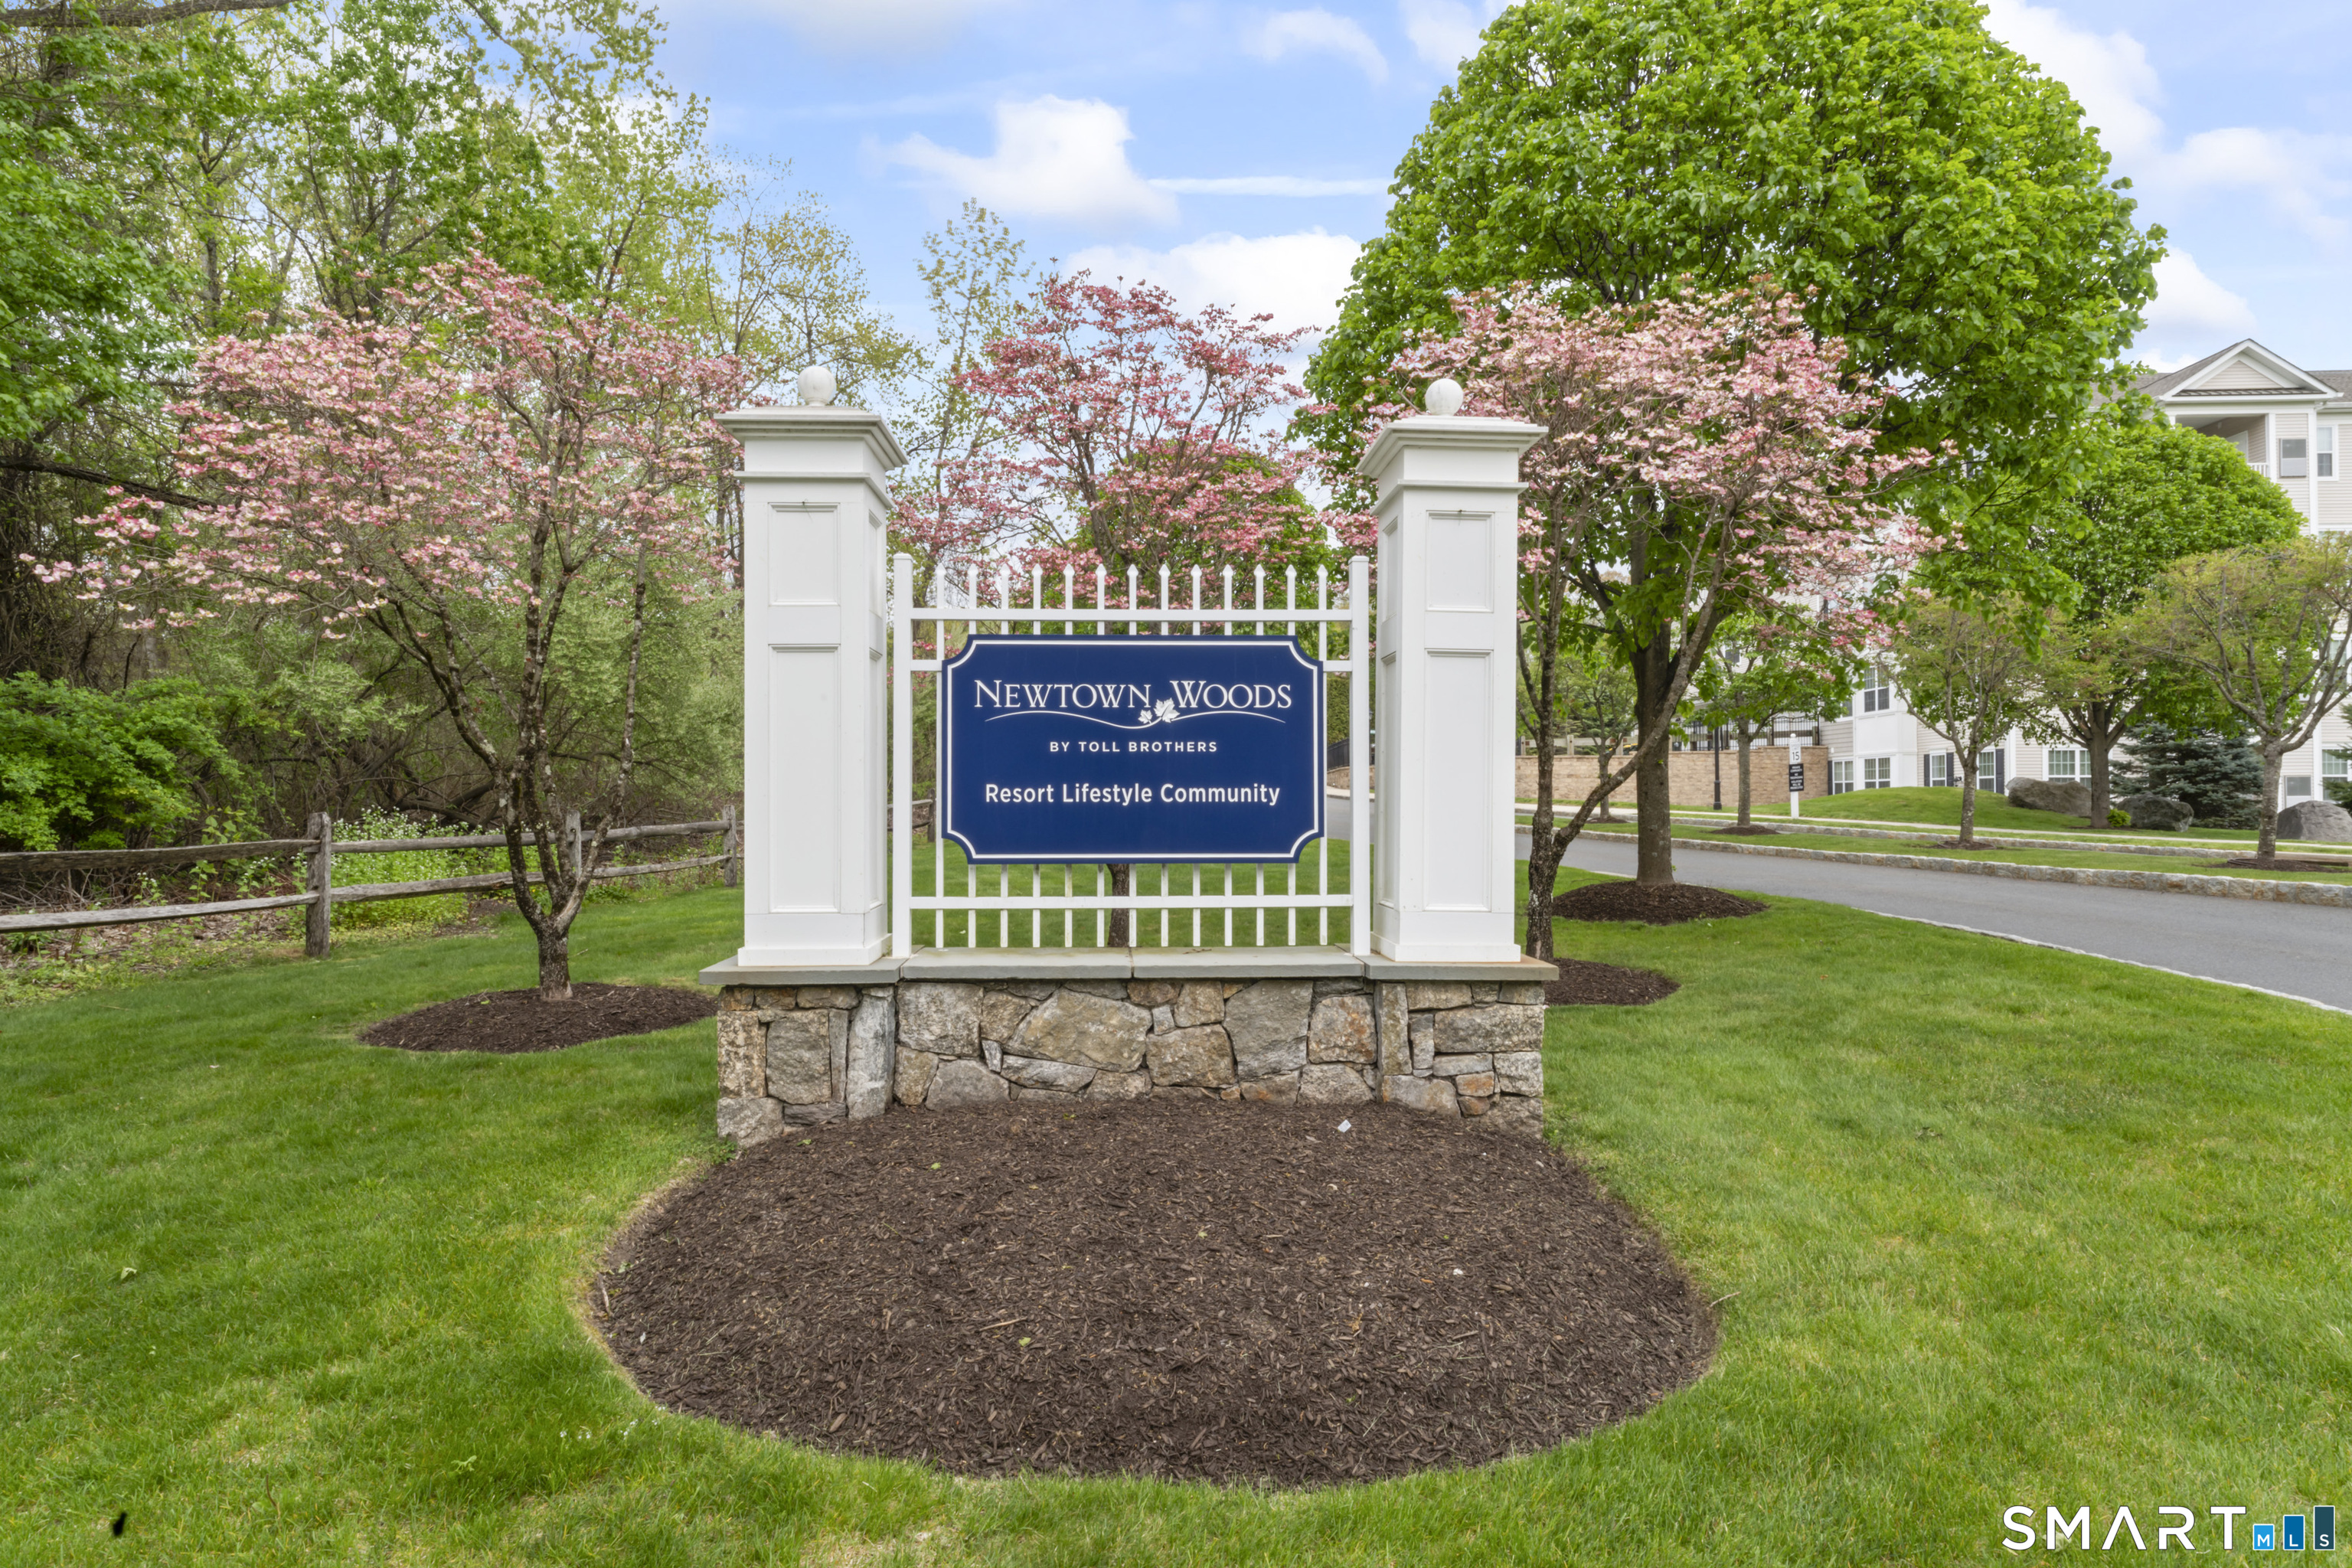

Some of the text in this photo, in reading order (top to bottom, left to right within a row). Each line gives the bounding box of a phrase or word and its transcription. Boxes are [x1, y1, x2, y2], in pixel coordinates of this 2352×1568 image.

[974, 679, 1292, 709] NEWTOWN WOODS
[1050, 741, 1217, 753] BY TOLL BROTHERS
[1792, 751, 1800, 761] 15
[985, 782, 1280, 806] Resort Lifestyle Community
